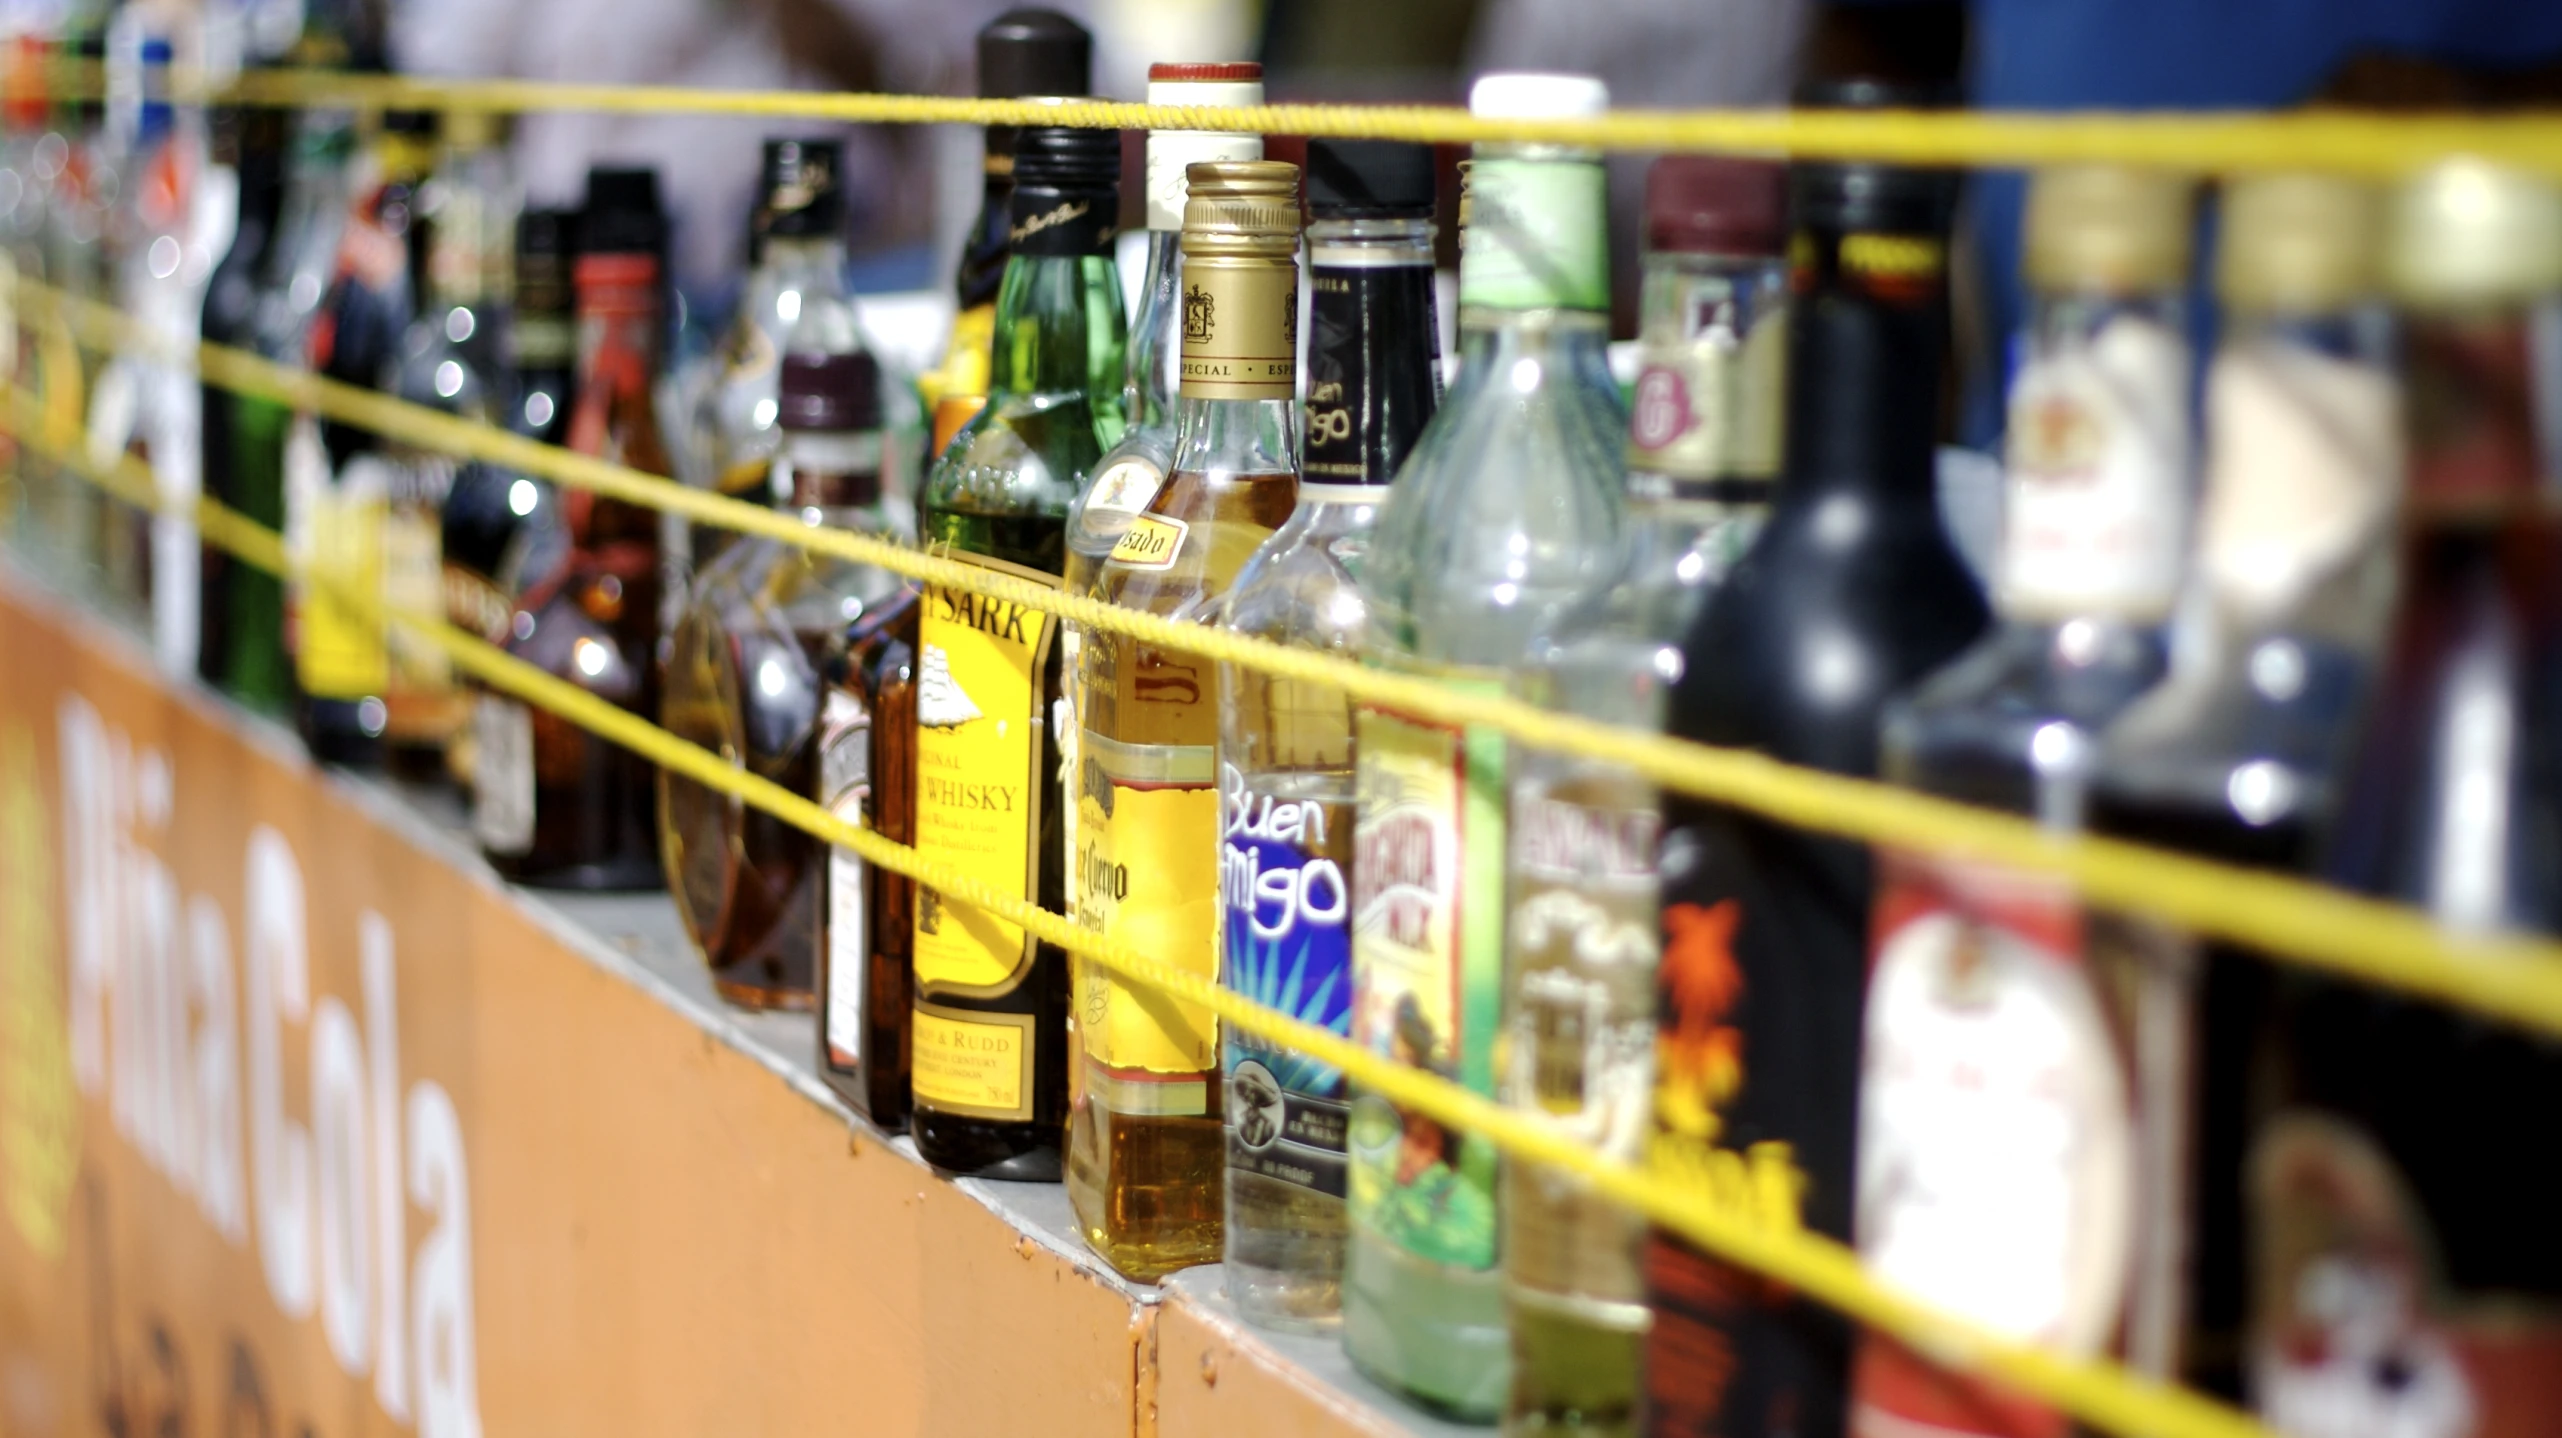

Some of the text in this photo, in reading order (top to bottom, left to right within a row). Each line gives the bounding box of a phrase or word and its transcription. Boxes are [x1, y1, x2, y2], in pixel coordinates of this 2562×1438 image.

[941, 586, 1027, 645] SARK
[927, 775, 1018, 812] WHISKY
[1224, 761, 1325, 844] Buen
[1087, 838, 1128, 902] Cuervo
[951, 1052, 997, 1069] CENTURY
[954, 1029, 1010, 1053] RUDD
[244, 823, 485, 1438] Cola
